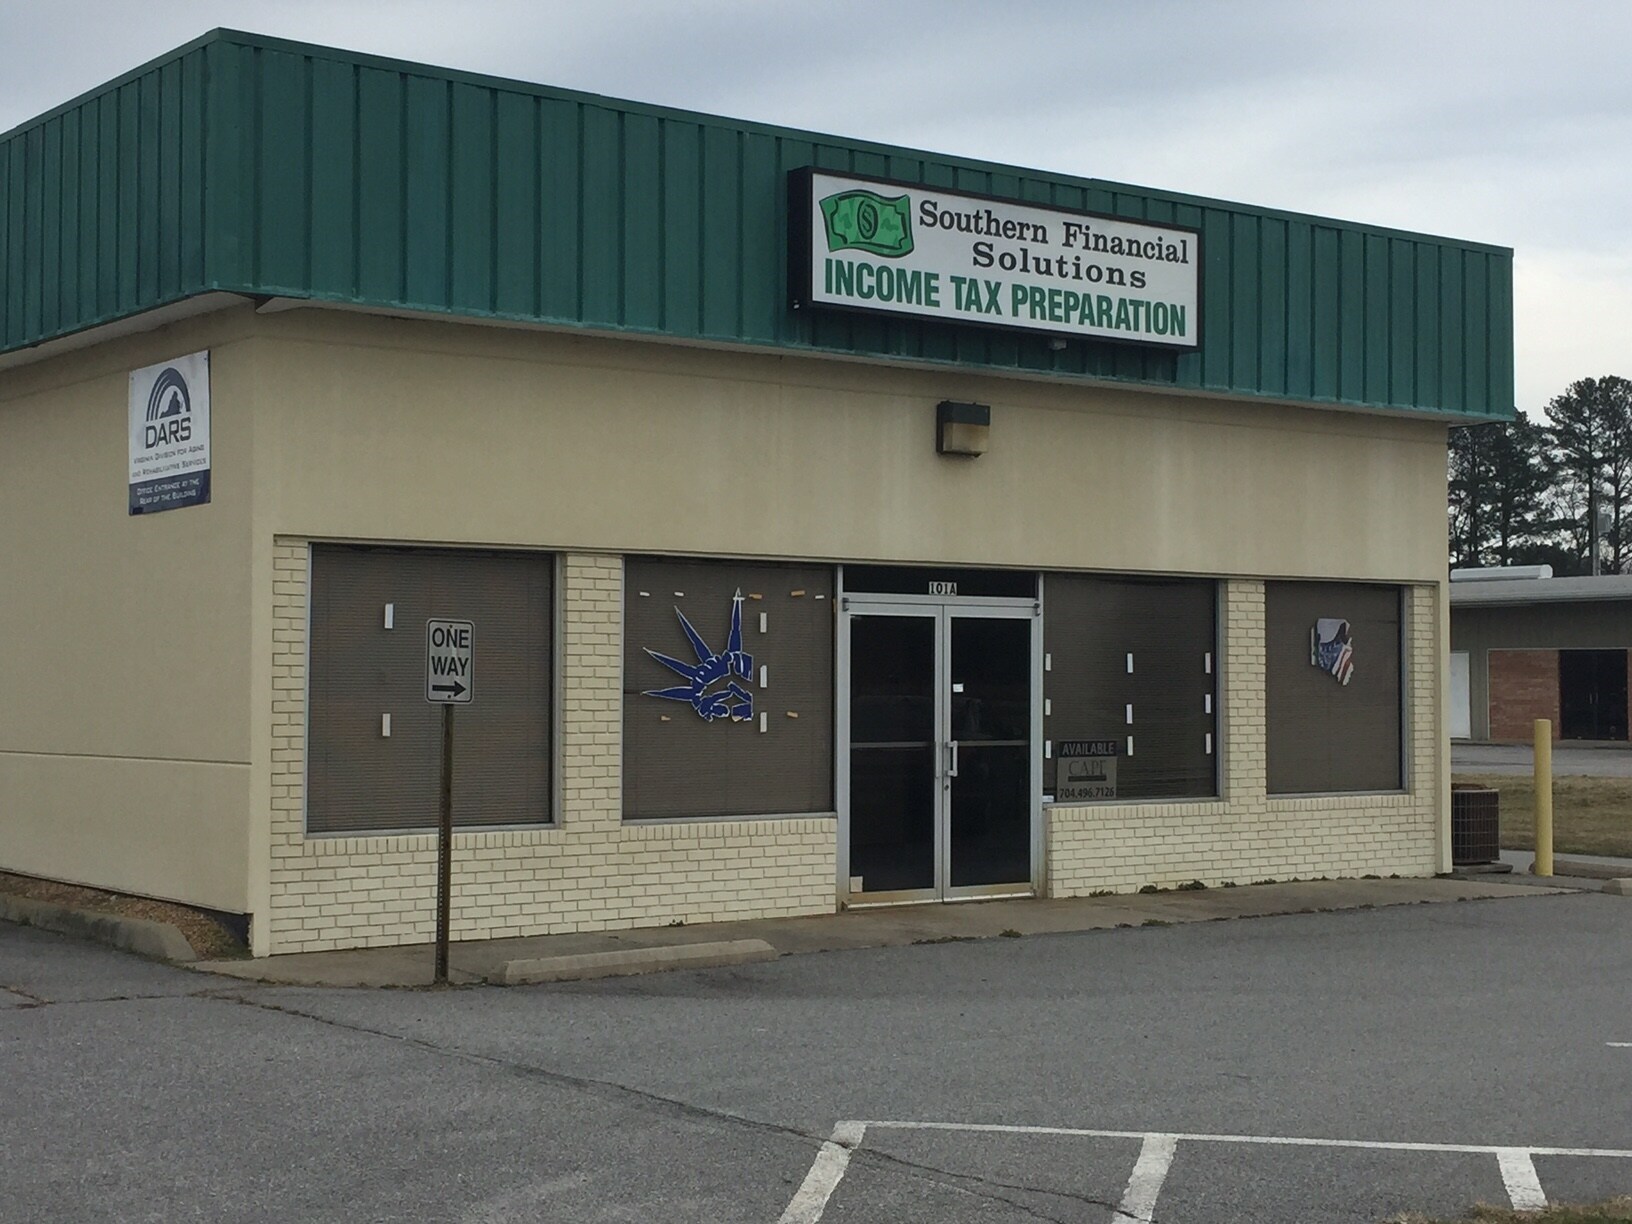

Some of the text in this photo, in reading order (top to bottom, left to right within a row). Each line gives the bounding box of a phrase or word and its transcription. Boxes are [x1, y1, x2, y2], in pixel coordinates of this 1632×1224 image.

[919, 199, 1189, 264] Southern Financial
[972, 241, 1147, 290] Solutions
[824, 258, 1186, 337] INCOME TAX PREPARATION
[145, 416, 192, 449] DARS
[930, 582, 956, 595] 101A
[432, 627, 469, 648] ONE
[431, 655, 469, 676] WAY
[1062, 742, 1114, 756] AVAILABLE
